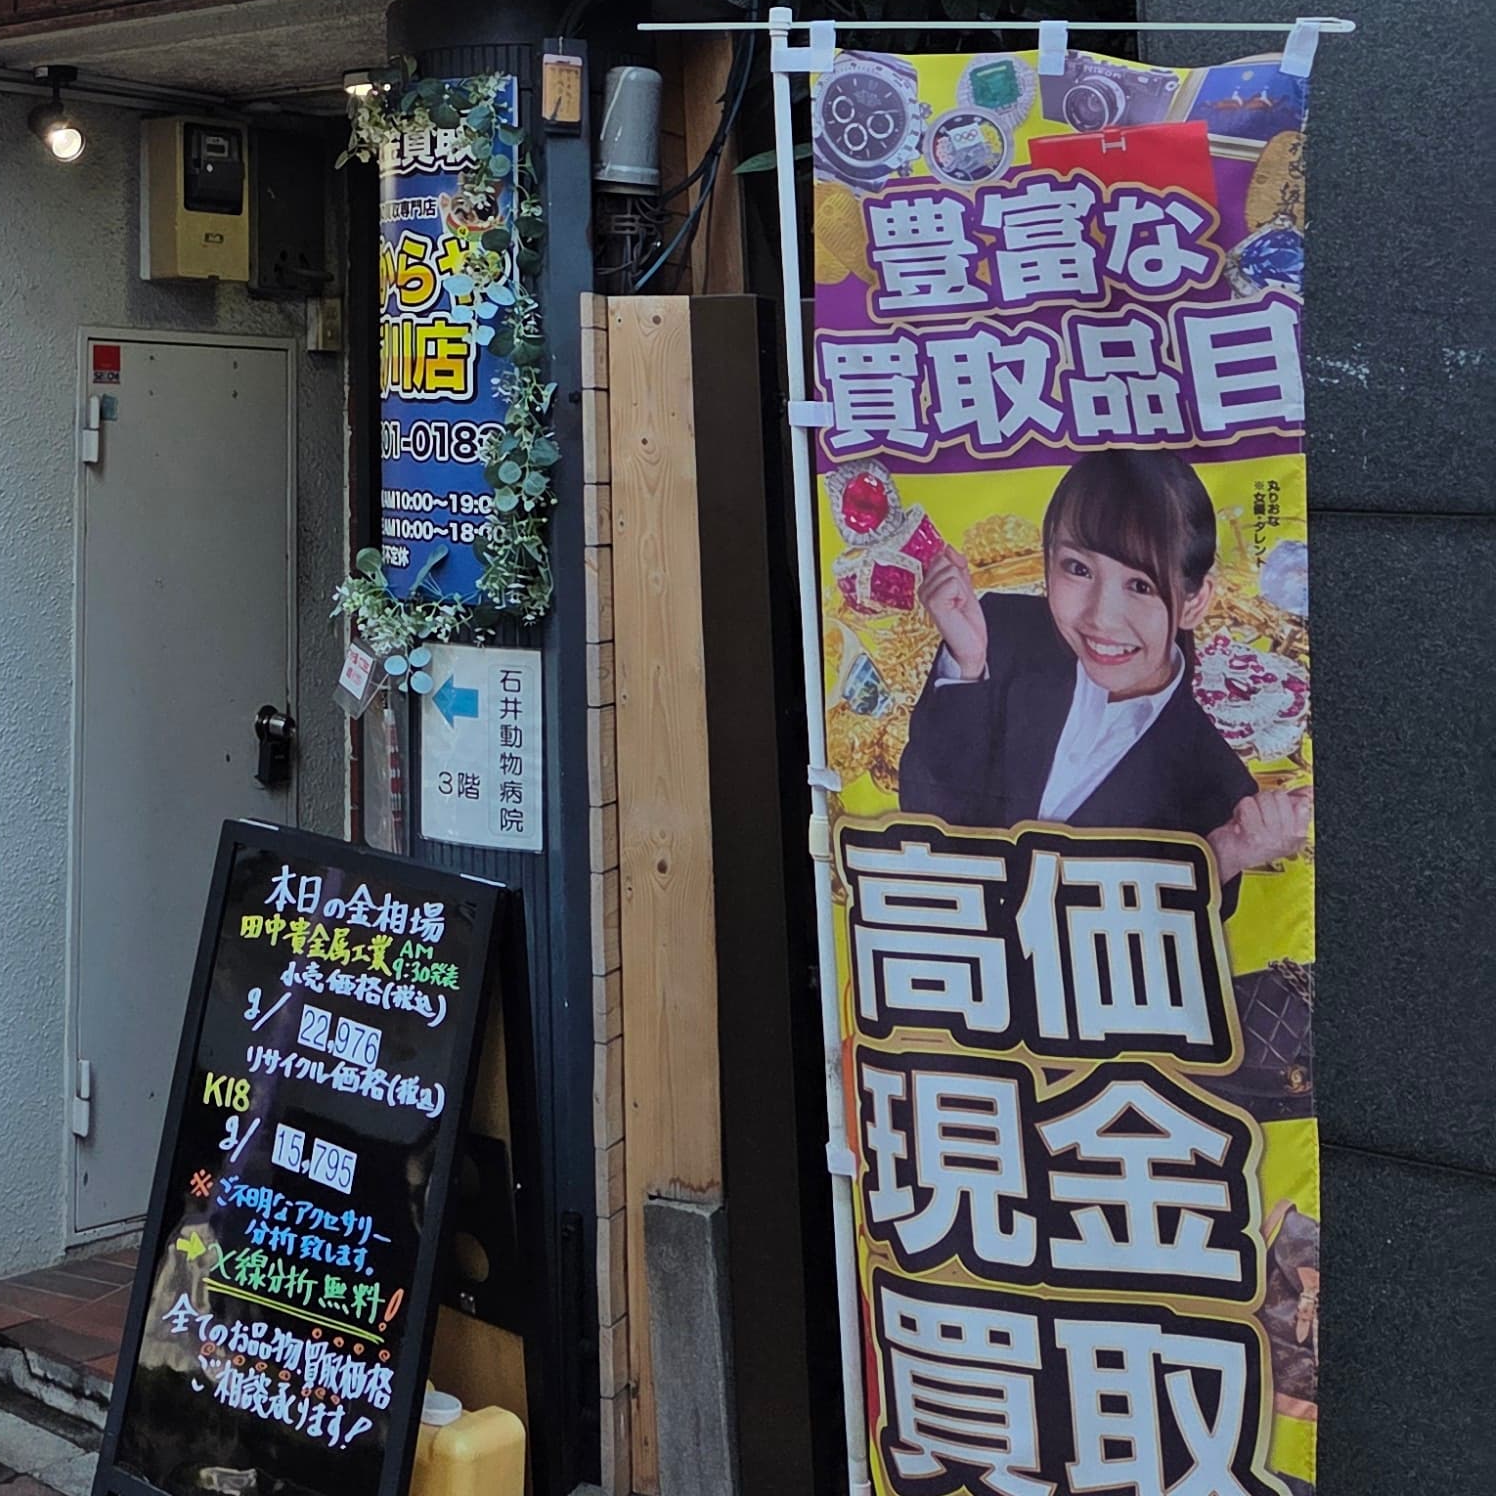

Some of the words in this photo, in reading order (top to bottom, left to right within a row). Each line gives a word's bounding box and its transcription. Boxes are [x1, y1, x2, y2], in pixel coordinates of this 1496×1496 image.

[869, 181, 1210, 310] 豊富な
[821, 301, 1304, 449] 買取品目
[438, 771, 481, 800] 3階
[499, 669, 524, 833] 石井動物病院
[264, 864, 445, 943] 本日の金相場
[240, 913, 393, 977] 田中貴金属工業
[399, 939, 434, 960] AM
[847, 841, 1215, 1046] 高価
[299, 1007, 381, 1066] 22,976
[203, 1072, 251, 1112] K18
[277, 1129, 355, 1190] 15,795
[861, 1063, 1242, 1282] 現金
[880, 1286, 1247, 1496] 買取
